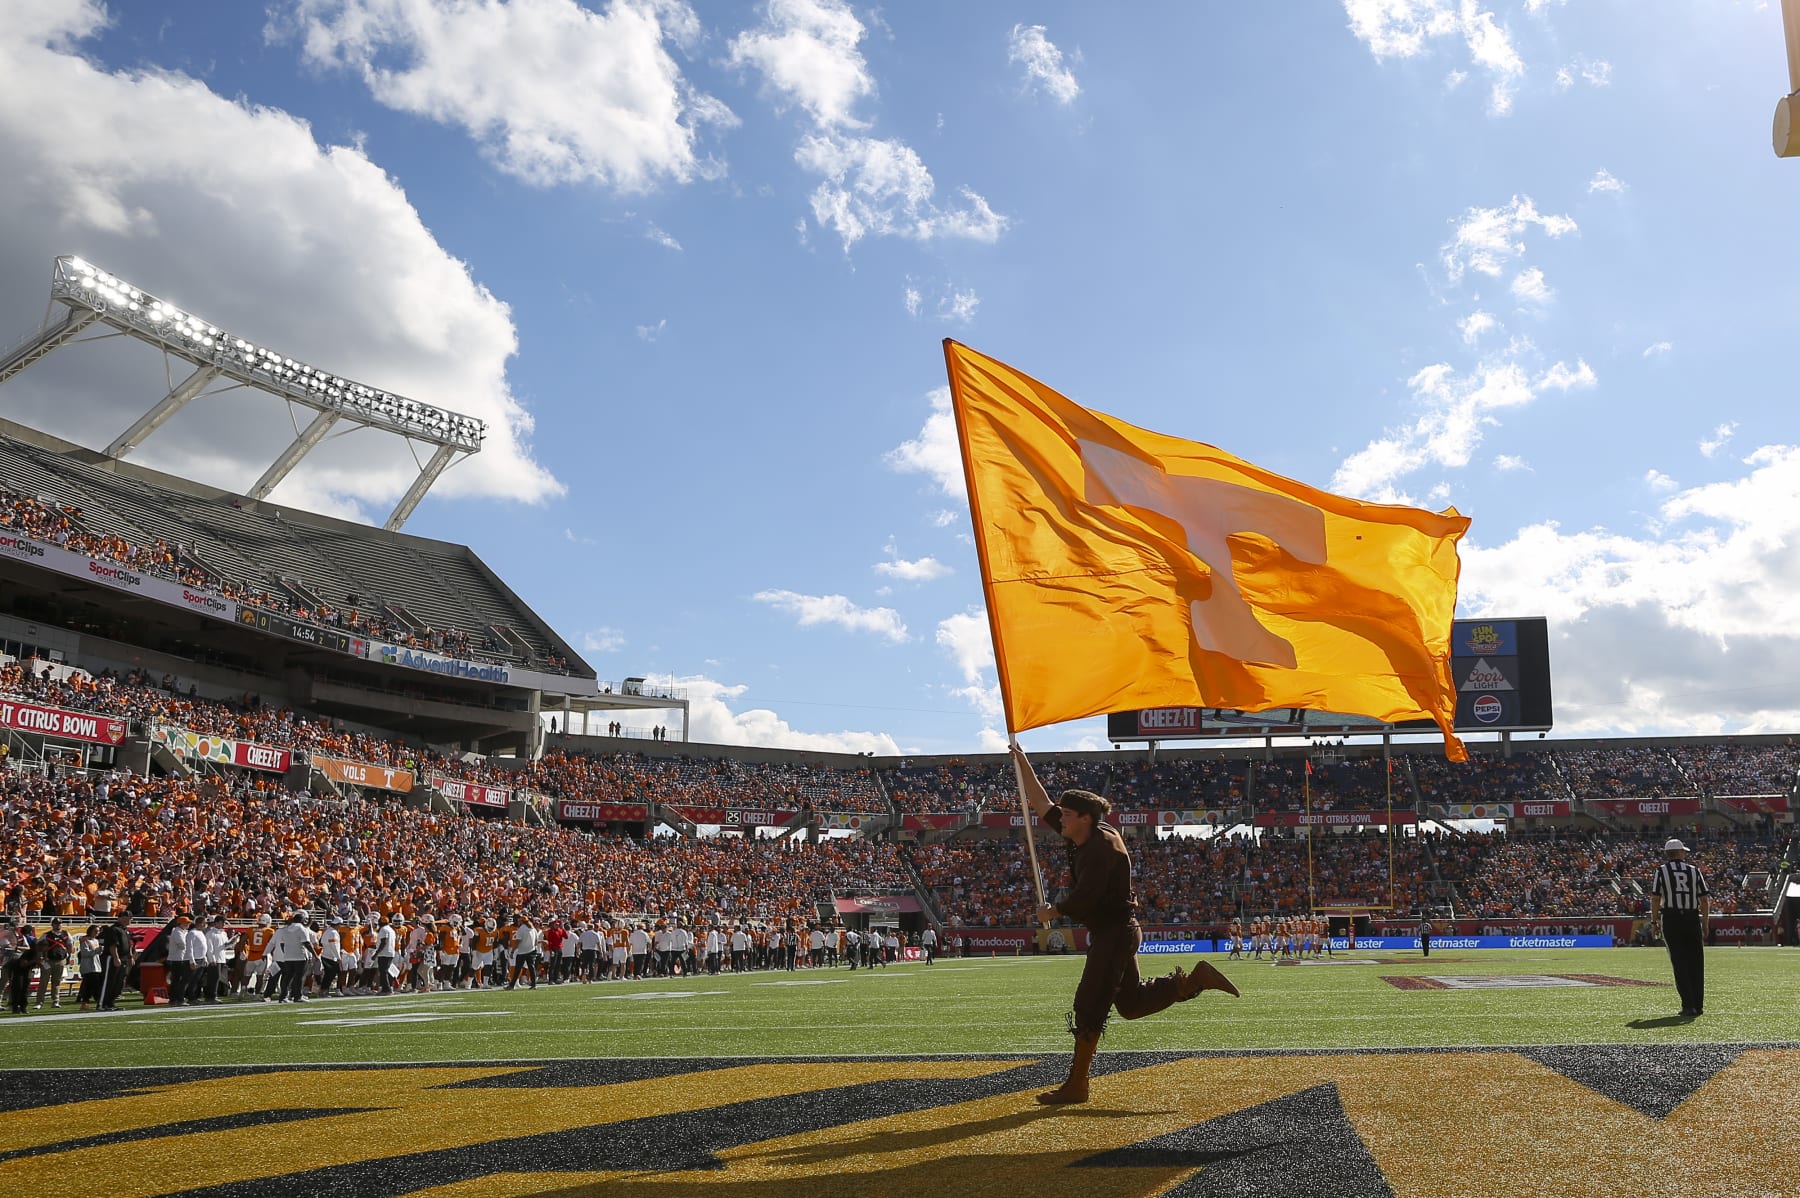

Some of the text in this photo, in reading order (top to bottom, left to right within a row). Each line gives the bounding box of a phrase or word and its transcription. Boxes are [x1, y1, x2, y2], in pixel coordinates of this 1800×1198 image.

[89, 561, 141, 586] SportClips
[183, 589, 227, 612] SportClips
[261, 618, 266, 627] 0
[292, 625, 315, 641] 14:54
[341, 639, 346, 649] 7
[1472, 625, 1493, 636] FUN
[1473, 633, 1499, 644] SPOT
[401, 649, 509, 683] AdventHealth
[1468, 669, 1504, 683] Coors
[1475, 705, 1500, 713] PEPSI
[17, 708, 60, 732] CITRUS
[63, 715, 98, 738] BOWL
[343, 764, 366, 781] VOLS
[727, 812, 739, 822] 25
[1326, 814, 1350, 824] CITRUS
[1351, 814, 1372, 823] BOWL
[1673, 871, 1689, 892] R
[253, 931, 263, 946] 6
[1509, 937, 1577, 947] ticketmaster
[1137, 942, 1196, 953] cketmaster
